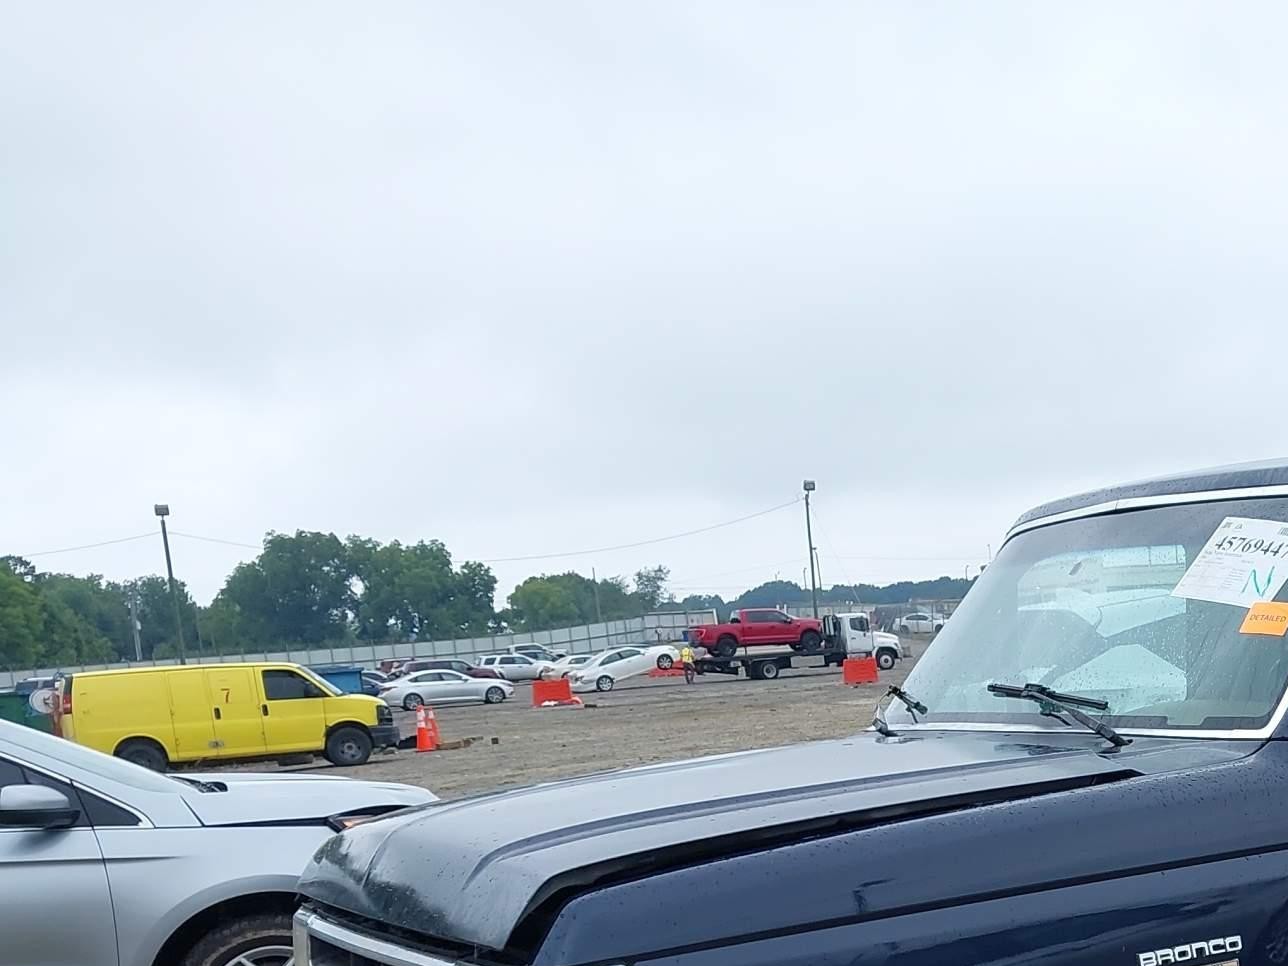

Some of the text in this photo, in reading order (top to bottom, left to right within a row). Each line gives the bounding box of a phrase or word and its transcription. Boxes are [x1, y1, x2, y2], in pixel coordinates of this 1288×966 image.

[1241, 566, 1275, 597] N
[1249, 614, 1287, 623] DETAILED
[221, 688, 230, 704] 7
